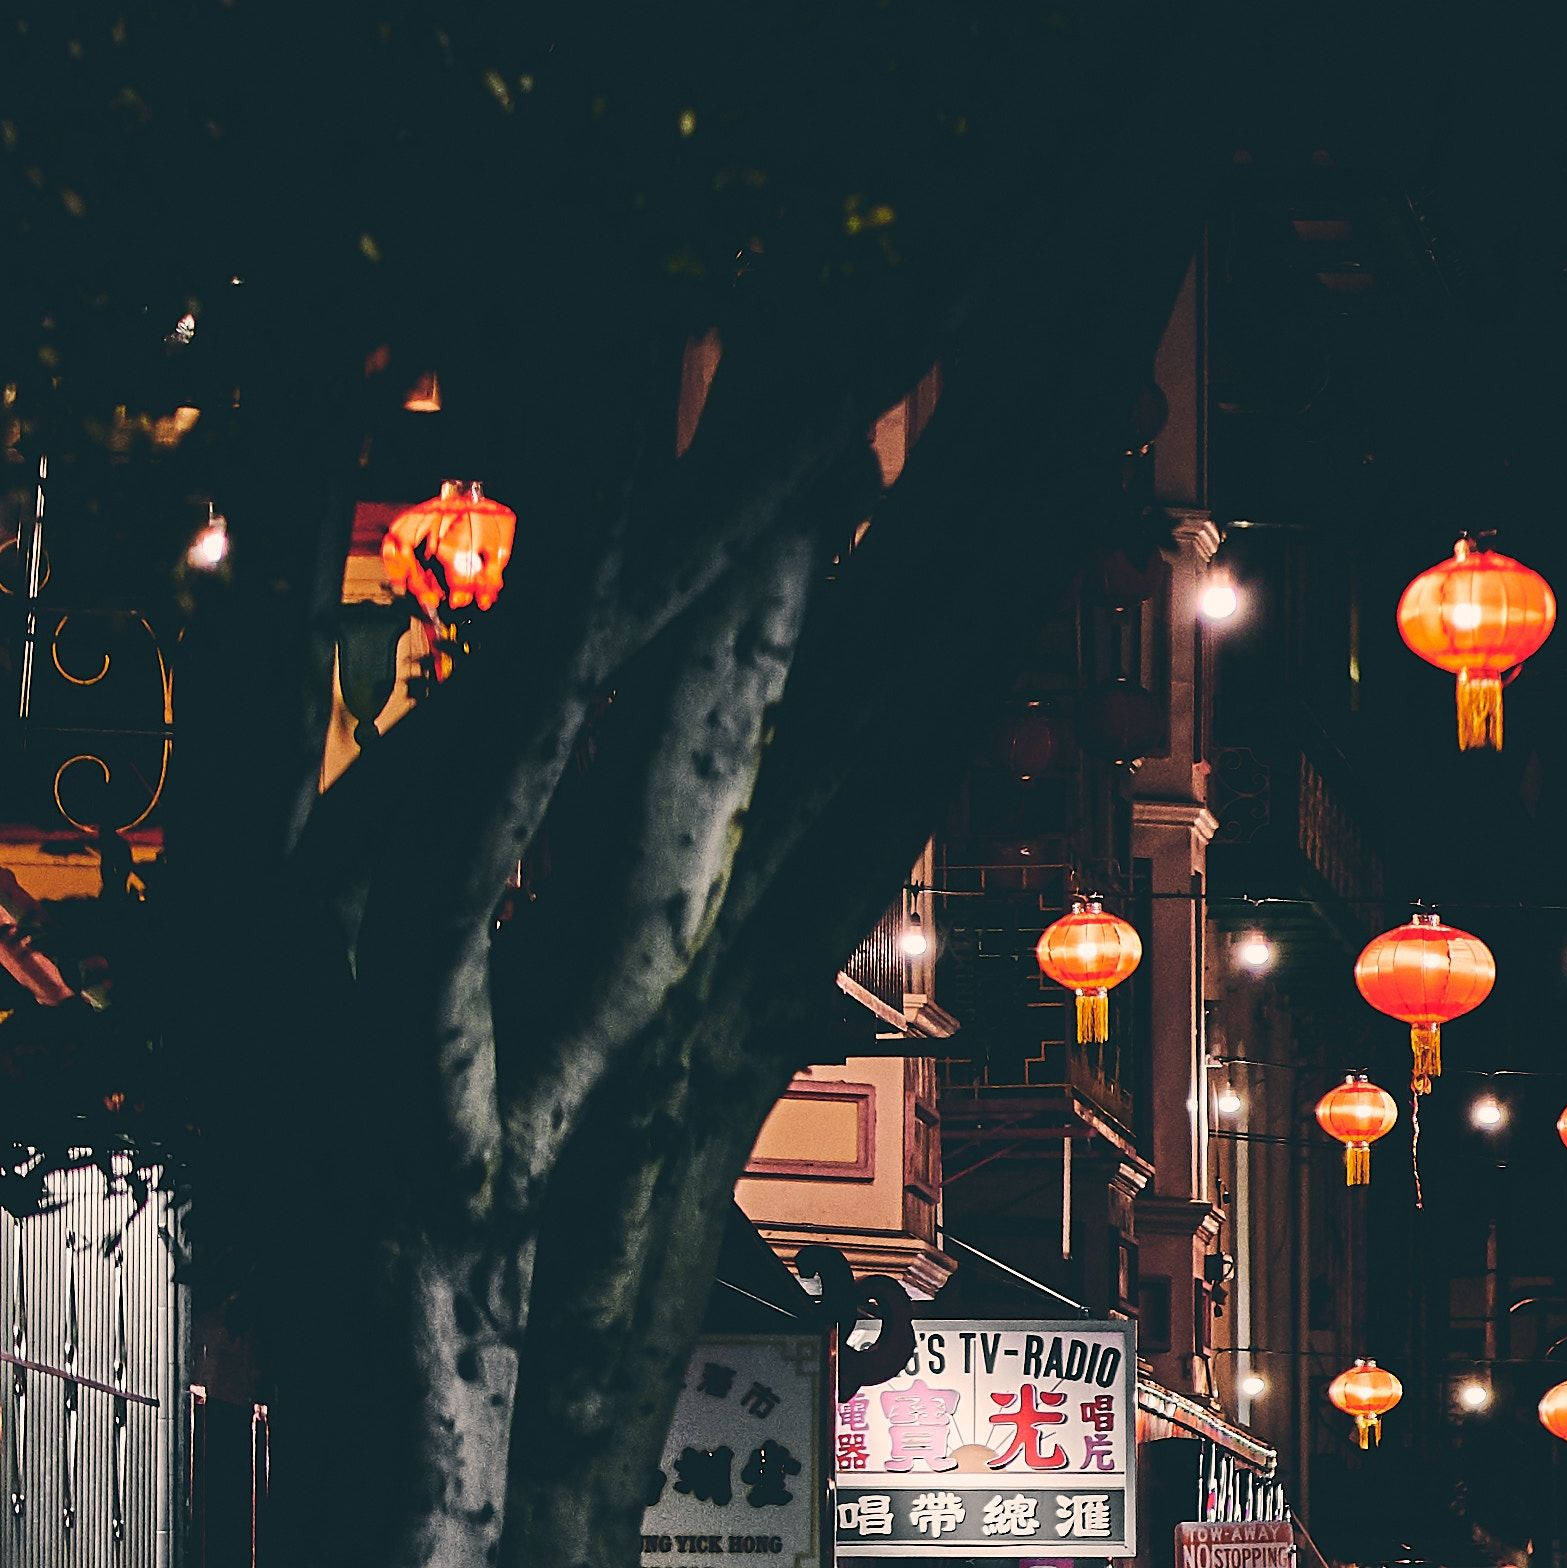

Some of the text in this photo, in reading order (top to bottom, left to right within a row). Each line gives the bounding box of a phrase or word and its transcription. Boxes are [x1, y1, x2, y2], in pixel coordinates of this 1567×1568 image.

[959, 1332, 1122, 1389] TV-RADIO
[1079, 1394, 1115, 1471] 唱片
[728, 1535, 783, 1553] HONG
[1187, 1525, 1281, 1542] TOW-AWAY
